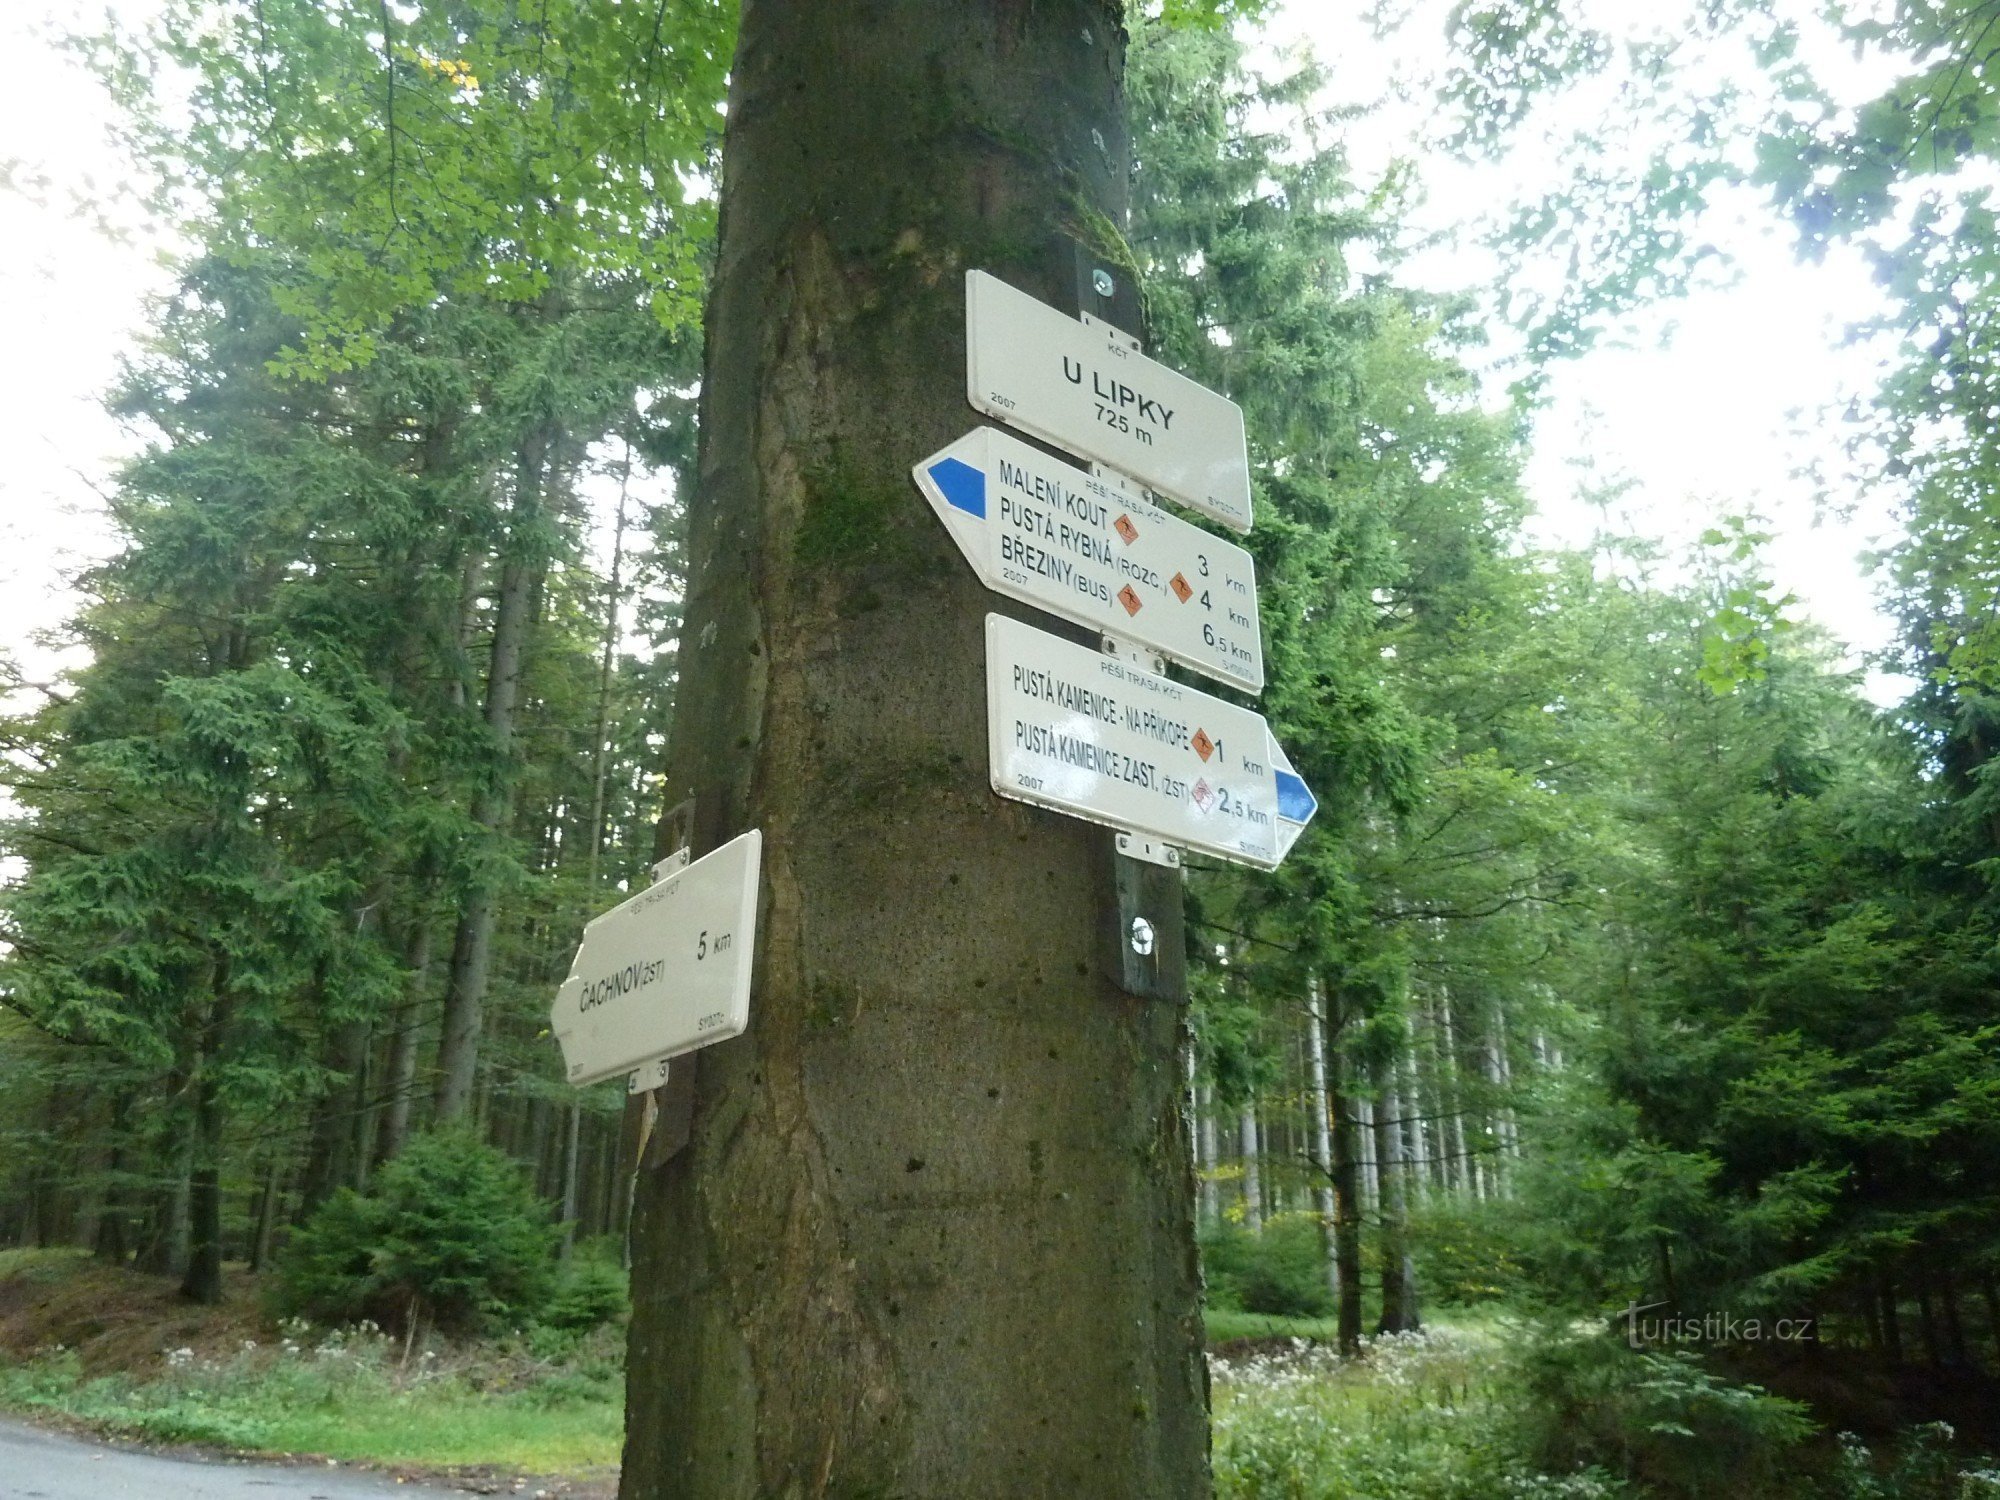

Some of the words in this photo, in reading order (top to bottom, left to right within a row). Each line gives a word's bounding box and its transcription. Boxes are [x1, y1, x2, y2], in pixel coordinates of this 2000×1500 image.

[1107, 343, 1128, 360] KČT
[990, 391, 1016, 410] 2007
[1063, 355, 1082, 384] U
[1093, 371, 1175, 430] LIPKY
[1094, 402, 1130, 434] 725
[1135, 427, 1153, 446] m
[1000, 459, 1061, 509] MALENÍ
[1065, 490, 1108, 530] KOUT
[1001, 496, 1056, 543] PUSTÁ
[1060, 523, 1114, 569] RYBNÁ
[1002, 567, 1029, 586] 2007
[1197, 554, 1209, 577] 3
[1225, 573, 1246, 595] km
[1200, 589, 1212, 611] 4
[1228, 608, 1250, 628] km
[1203, 623, 1227, 653] 6,5
[1231, 642, 1252, 663] km
[1101, 661, 1125, 681] PĚŠÍ
[1127, 671, 1161, 692] TRASA
[1014, 664, 1055, 704] PUSTÁ
[1057, 680, 1117, 725] KAMENICE
[1125, 705, 1143, 735] NA
[1016, 720, 1057, 760] PUSTÁ
[1059, 734, 1120, 778] KAMENICE
[1123, 756, 1159, 792] ZAST.
[1214, 739, 1223, 763] 1
[1242, 755, 1264, 776] km
[1018, 773, 1043, 791] 2007
[1218, 787, 1244, 817] 2,5
[1247, 803, 1269, 825] km
[697, 930, 708, 960] 5
[713, 933, 732, 954] km
